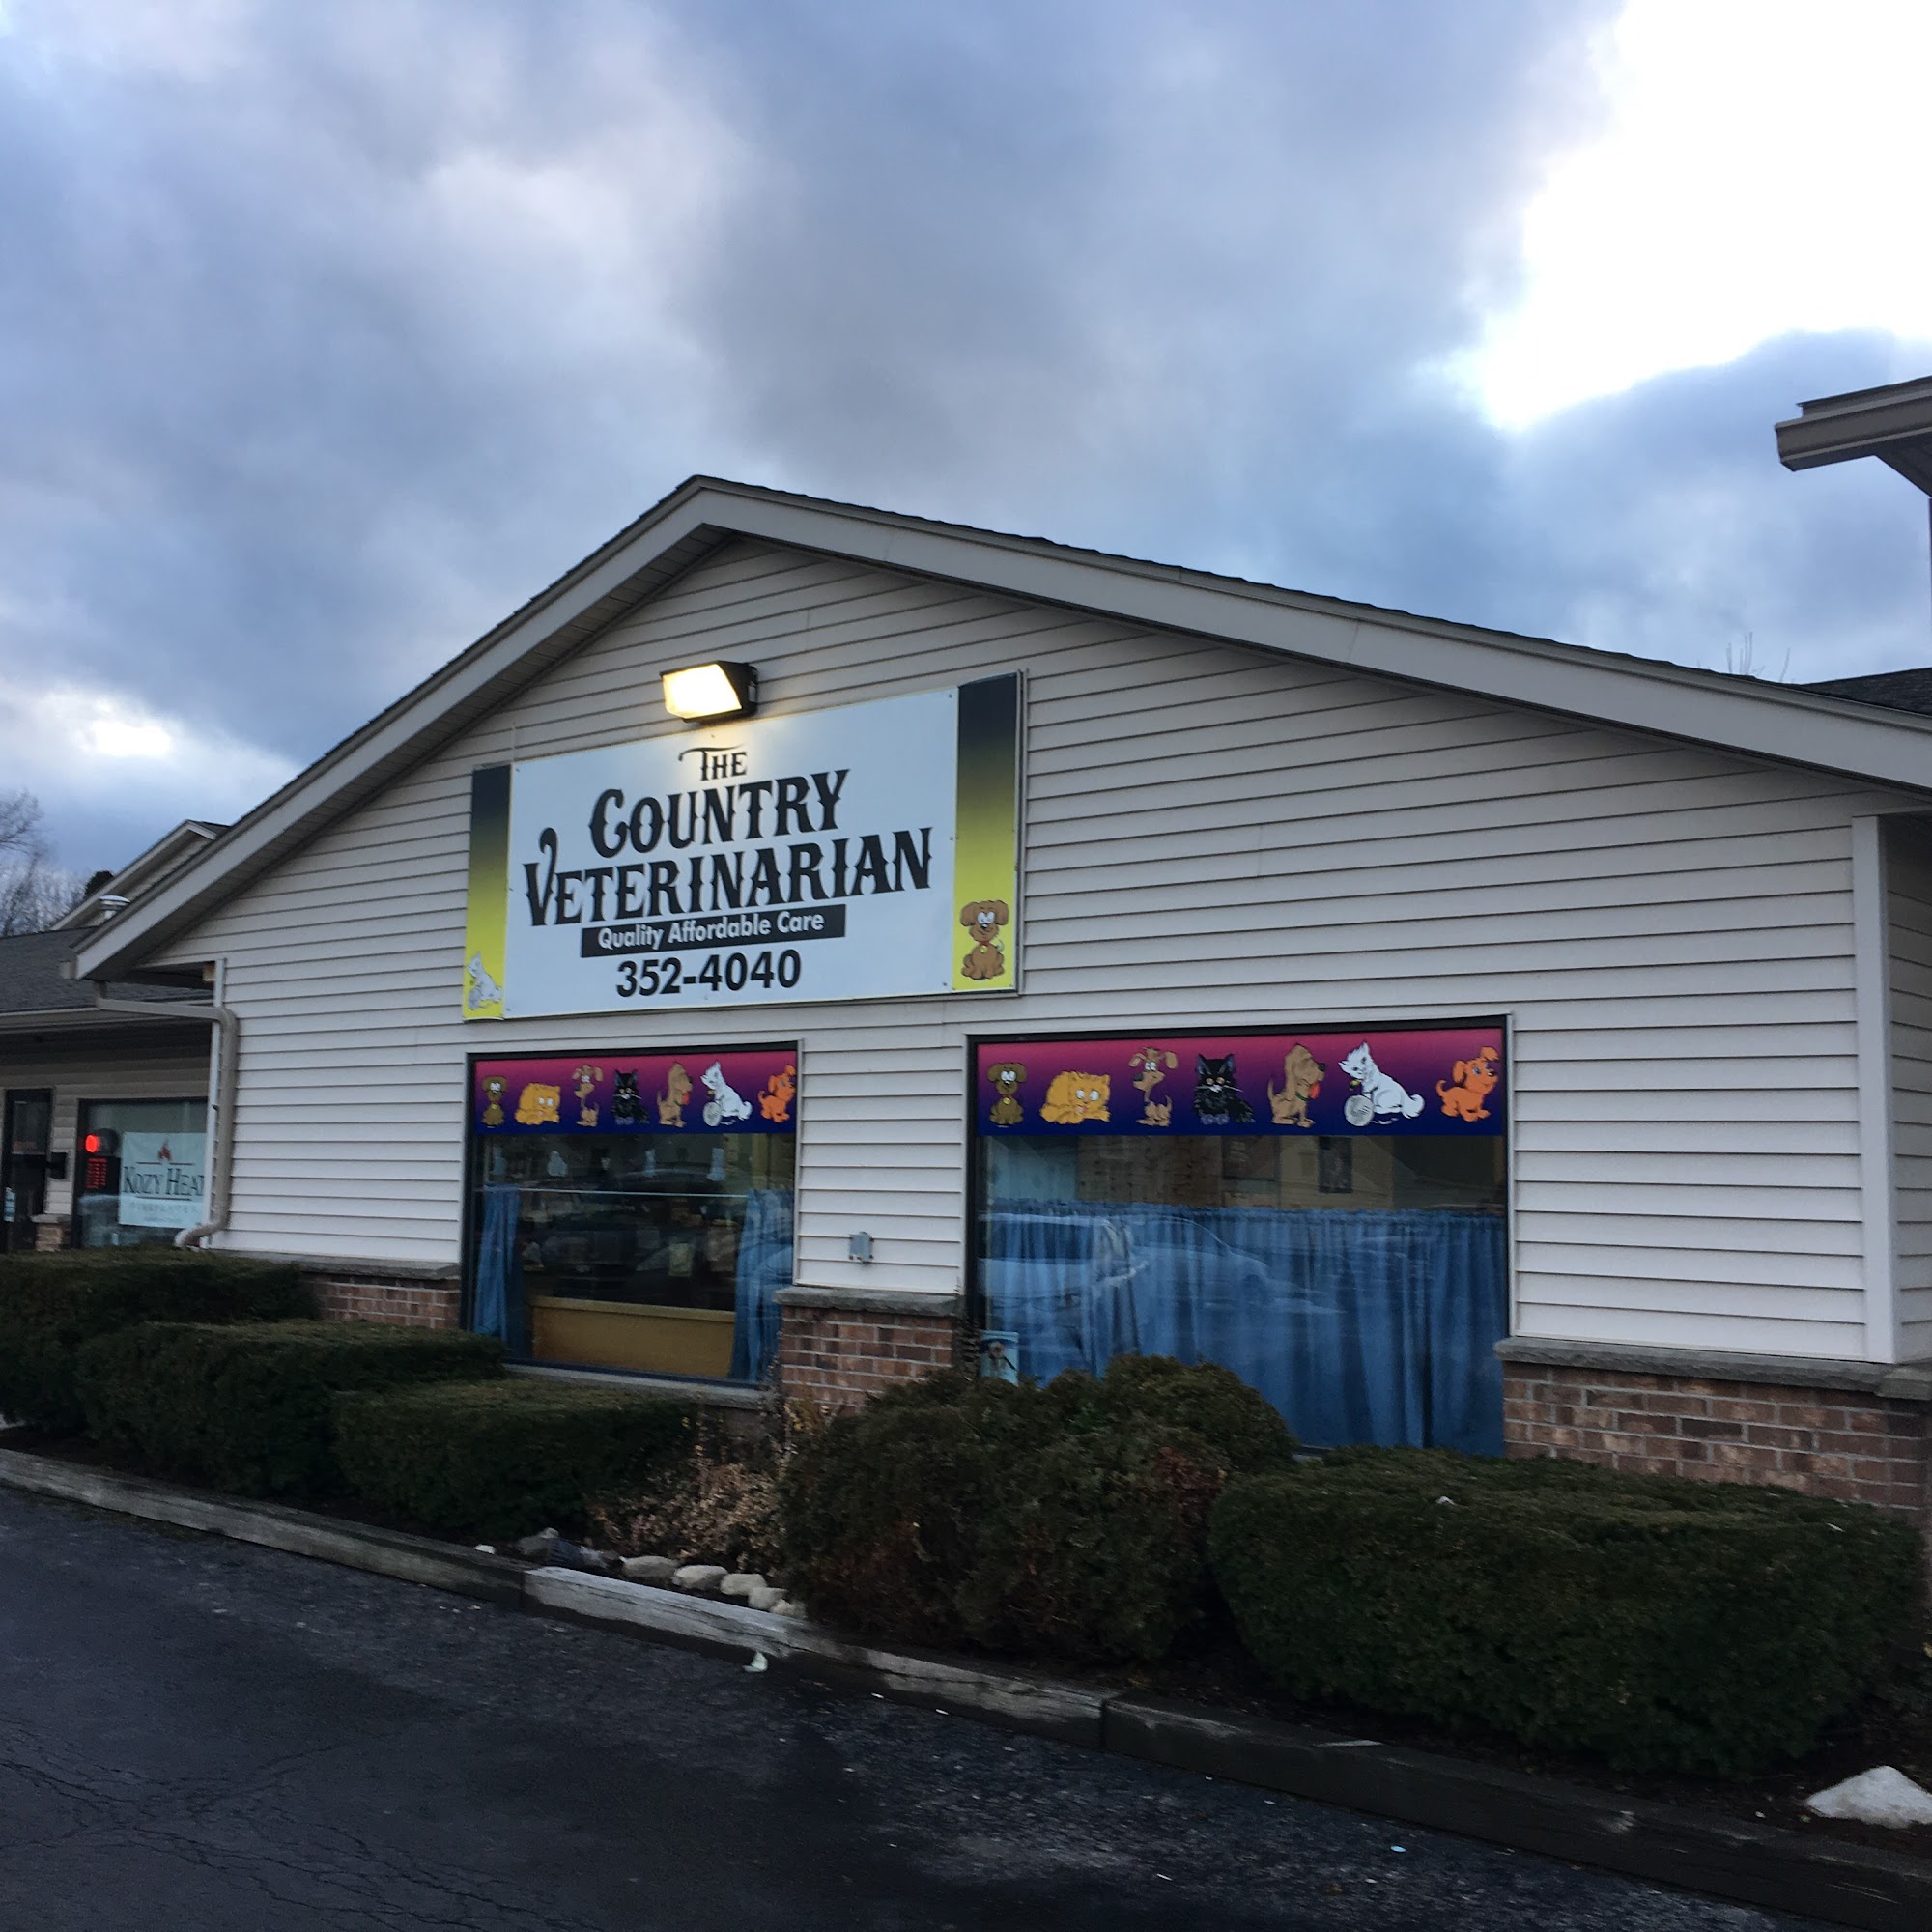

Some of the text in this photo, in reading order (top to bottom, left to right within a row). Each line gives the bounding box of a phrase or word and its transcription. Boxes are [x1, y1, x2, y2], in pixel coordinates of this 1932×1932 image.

[679, 745, 748, 781] THE
[588, 769, 851, 858] COUNTRY
[522, 827, 933, 926] VETERINARIAN
[597, 910, 825, 950] Quality Affordable Care
[616, 949, 802, 998] 352-4040
[122, 1166, 164, 1194] KOZY
